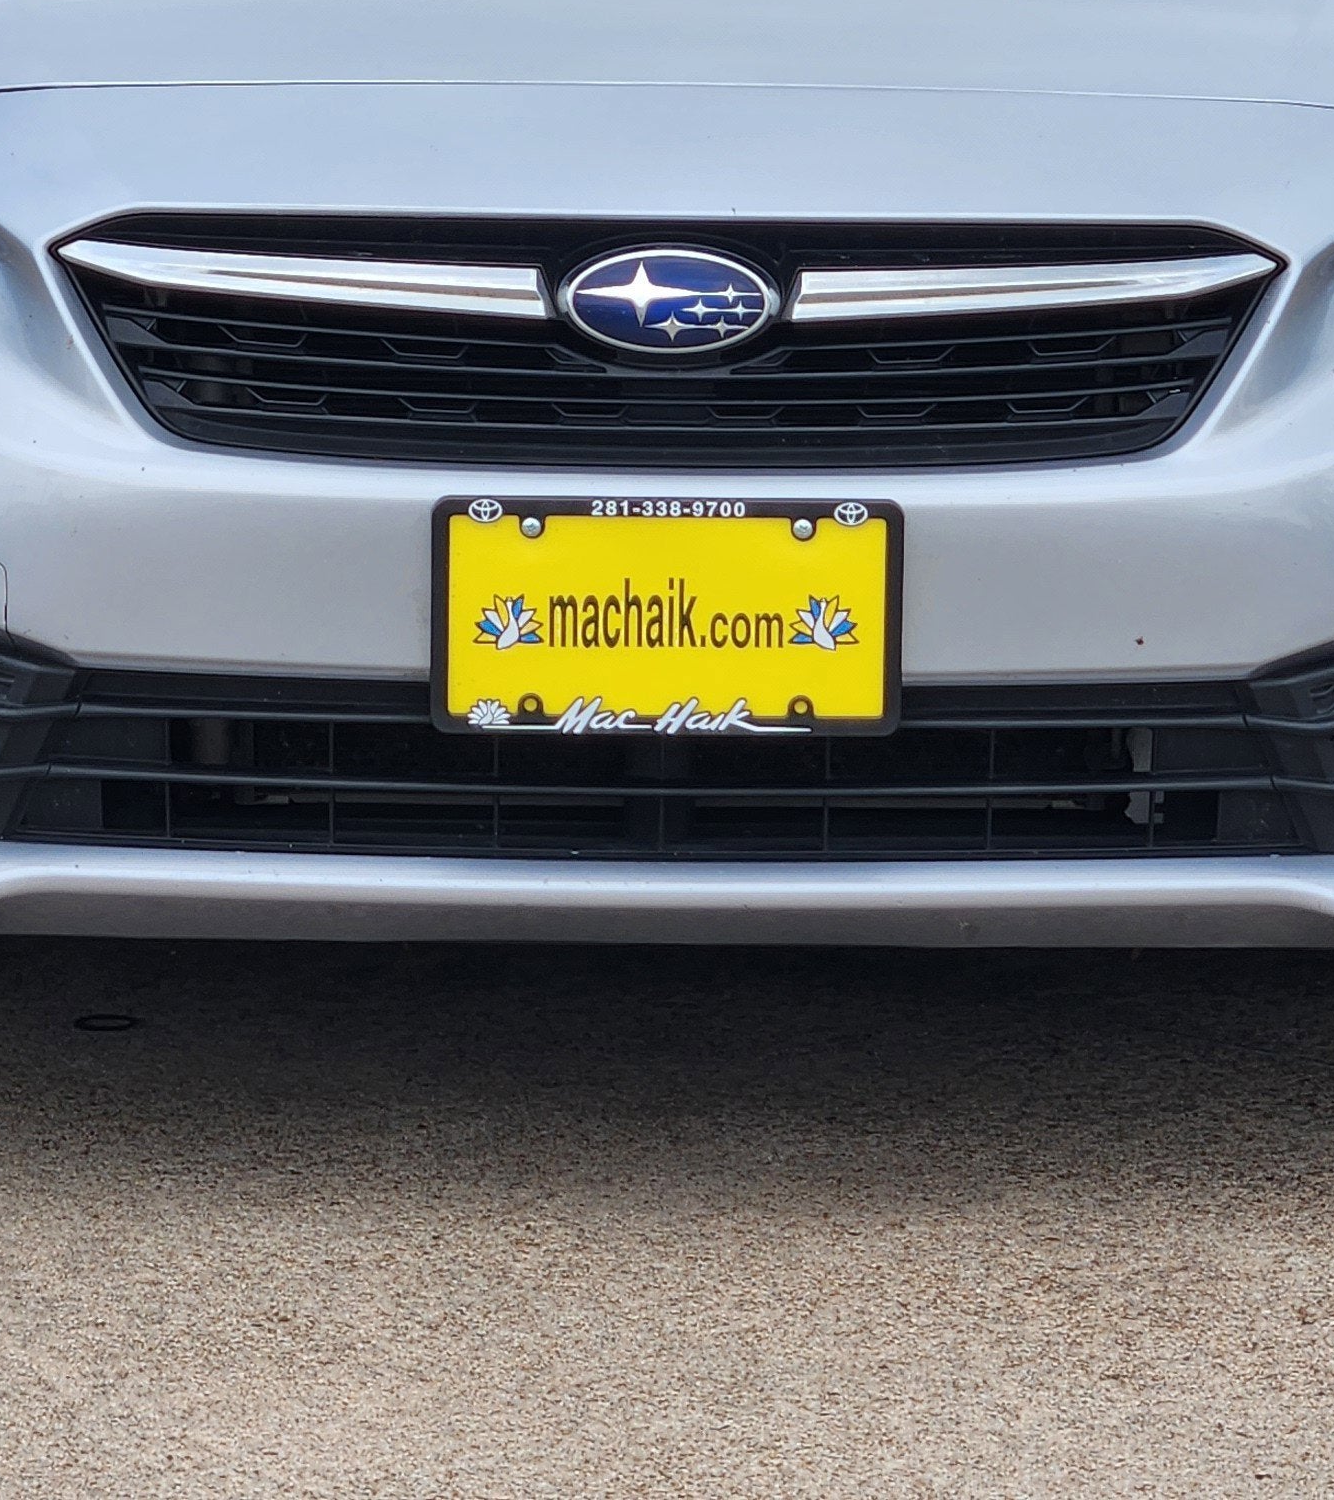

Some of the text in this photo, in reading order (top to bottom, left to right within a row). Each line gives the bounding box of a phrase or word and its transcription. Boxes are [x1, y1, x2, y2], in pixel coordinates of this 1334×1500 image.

[590, 499, 746, 517] 281-338-9700
[548, 577, 784, 649] machaik.com
[561, 696, 759, 736] Mac Haik
